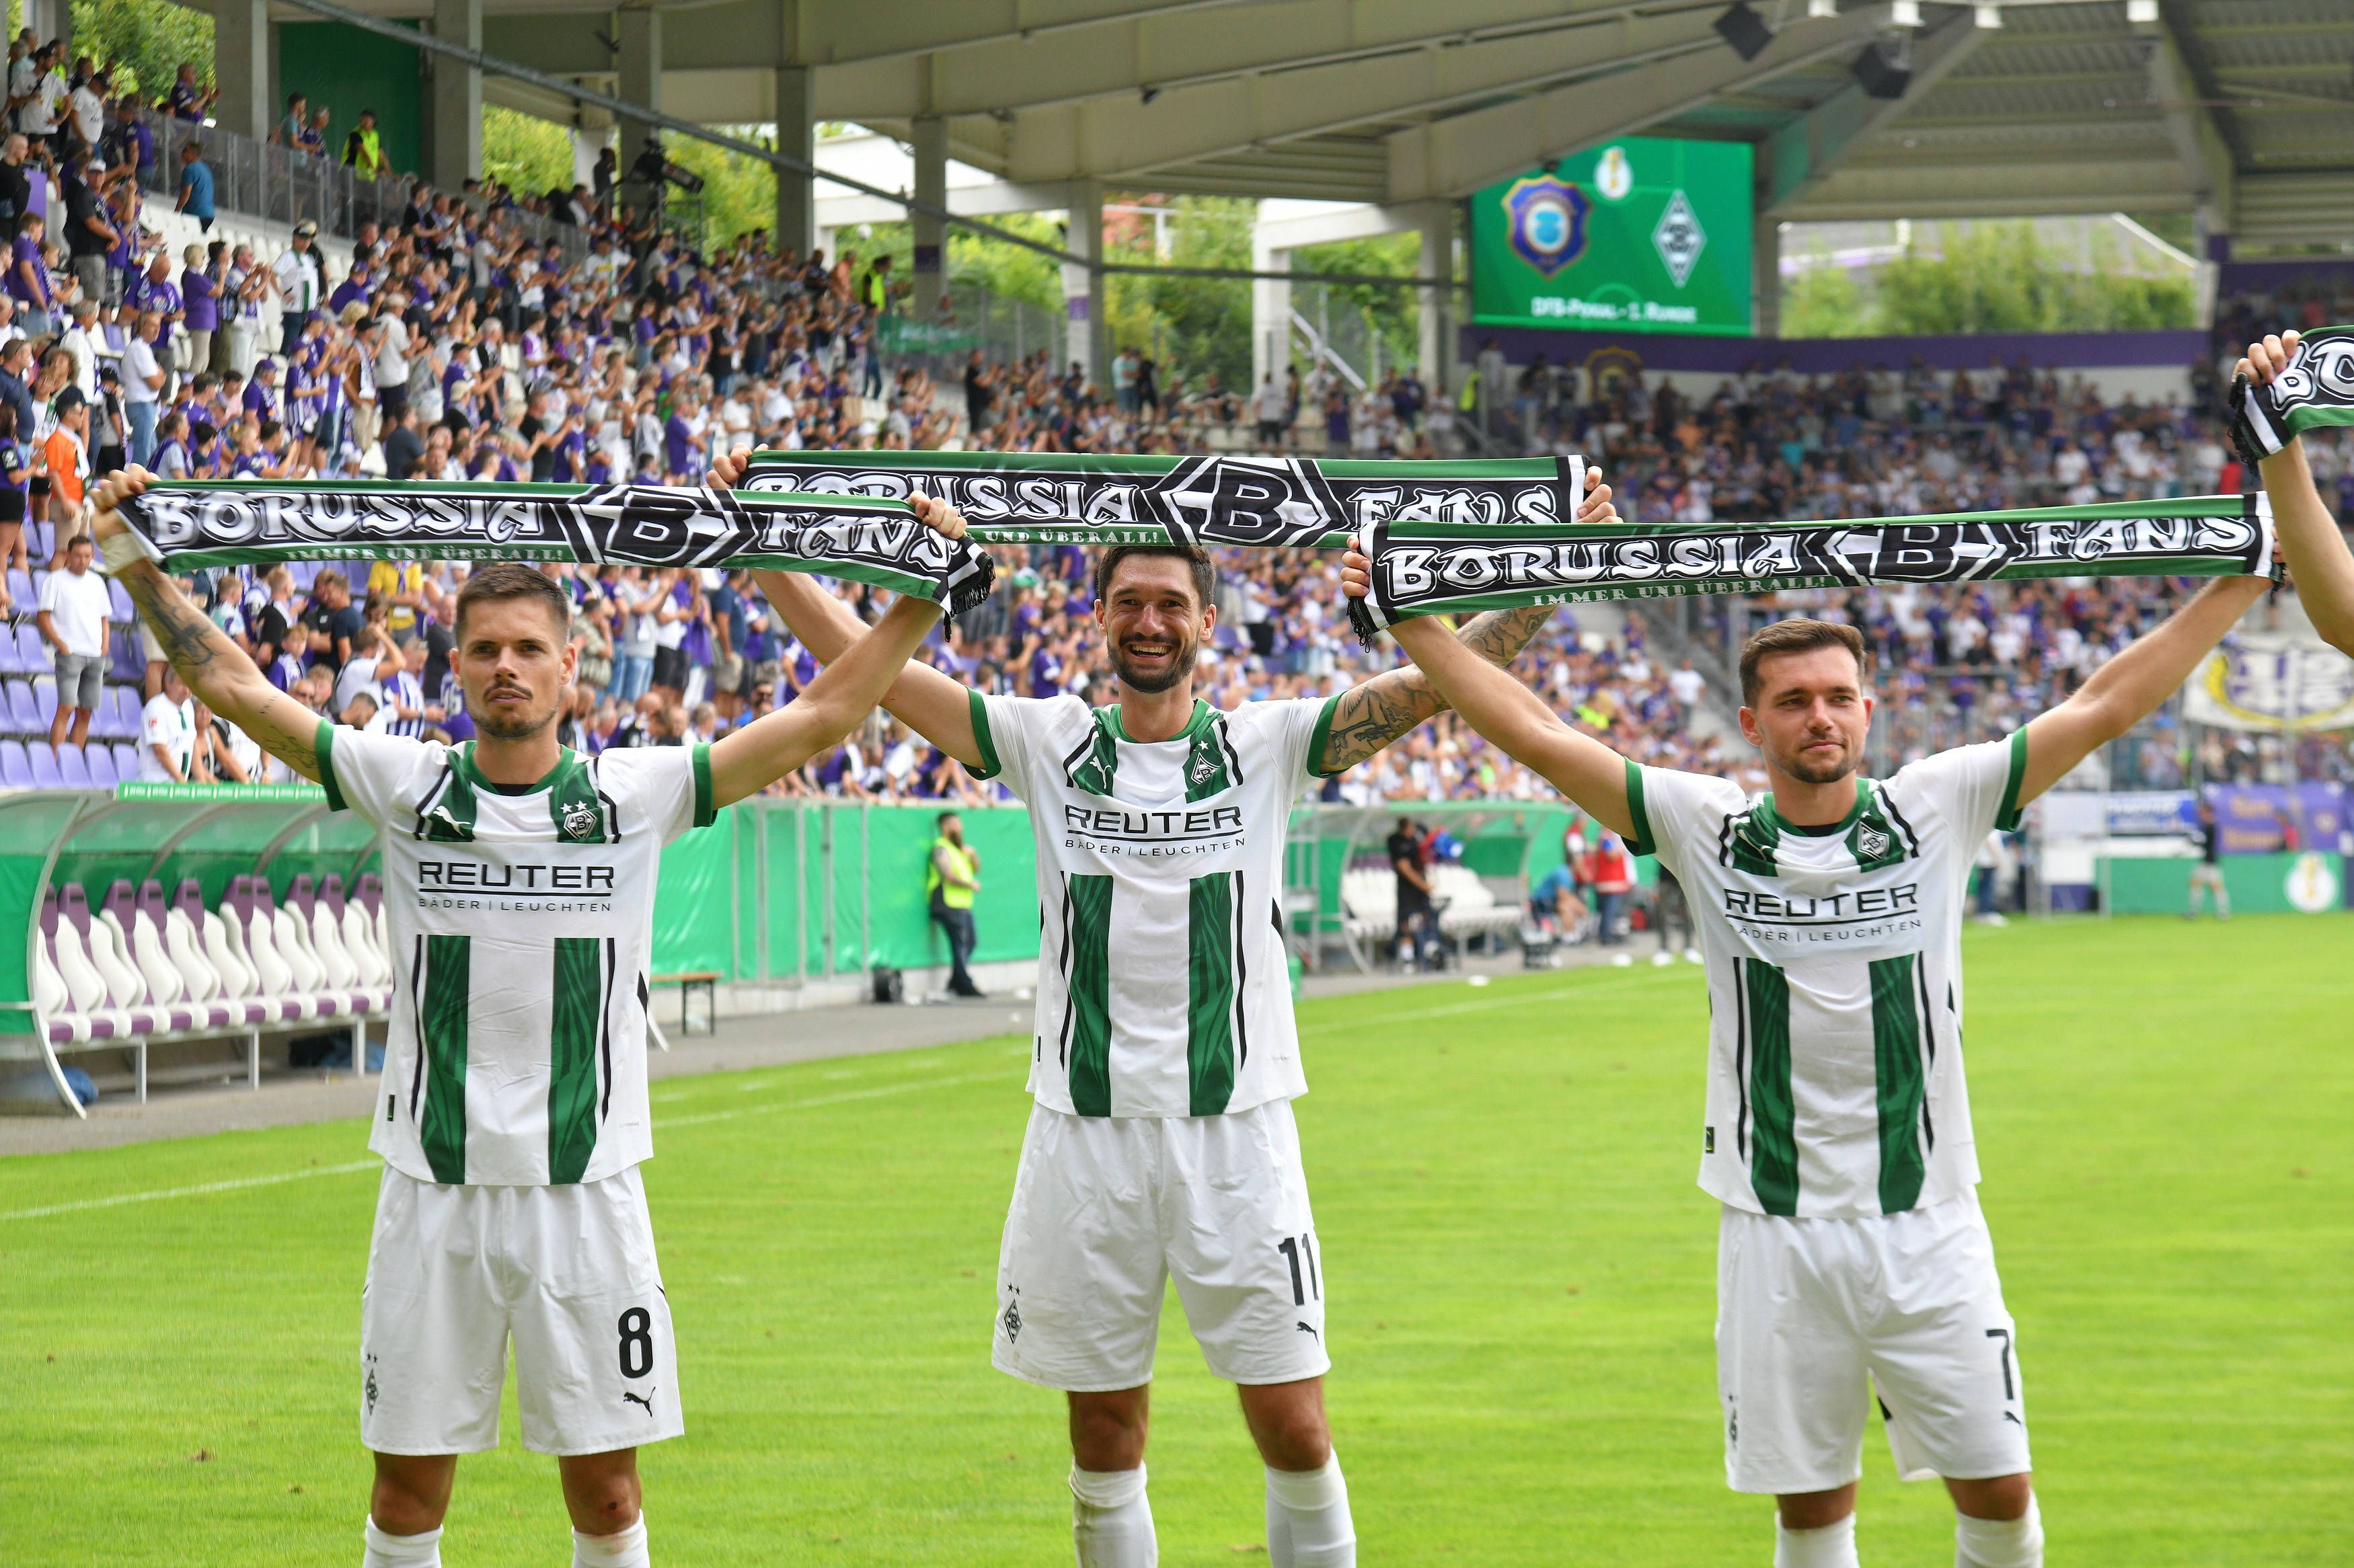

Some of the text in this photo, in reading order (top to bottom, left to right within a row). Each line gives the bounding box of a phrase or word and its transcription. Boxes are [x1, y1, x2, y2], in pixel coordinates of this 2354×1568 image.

[135, 490, 545, 548] BORUSSIA
[758, 511, 962, 573] FANS
[983, 531, 1030, 542] UND
[1038, 528, 1157, 543] ÜBERALL!
[385, 546, 432, 559] UND
[441, 545, 562, 561] ÜBERALL!
[1377, 533, 1801, 601] BORUSSIA
[2021, 516, 2256, 563] FANS
[1532, 576, 1825, 606] IMMER UND ÜBERALL!
[1065, 804, 1243, 834] REUTER
[1139, 837, 1246, 856] LEUCHTEN
[418, 861, 614, 889] REUTER
[418, 897, 611, 912] BÄDER LEUCHTEN
[1723, 883, 1918, 917] REUTER
[1809, 919, 1922, 941] LEUCHTEN
[1278, 1233, 1320, 1306] 11
[617, 1306, 653, 1379] 8
[1985, 1329, 2014, 1400] 7
